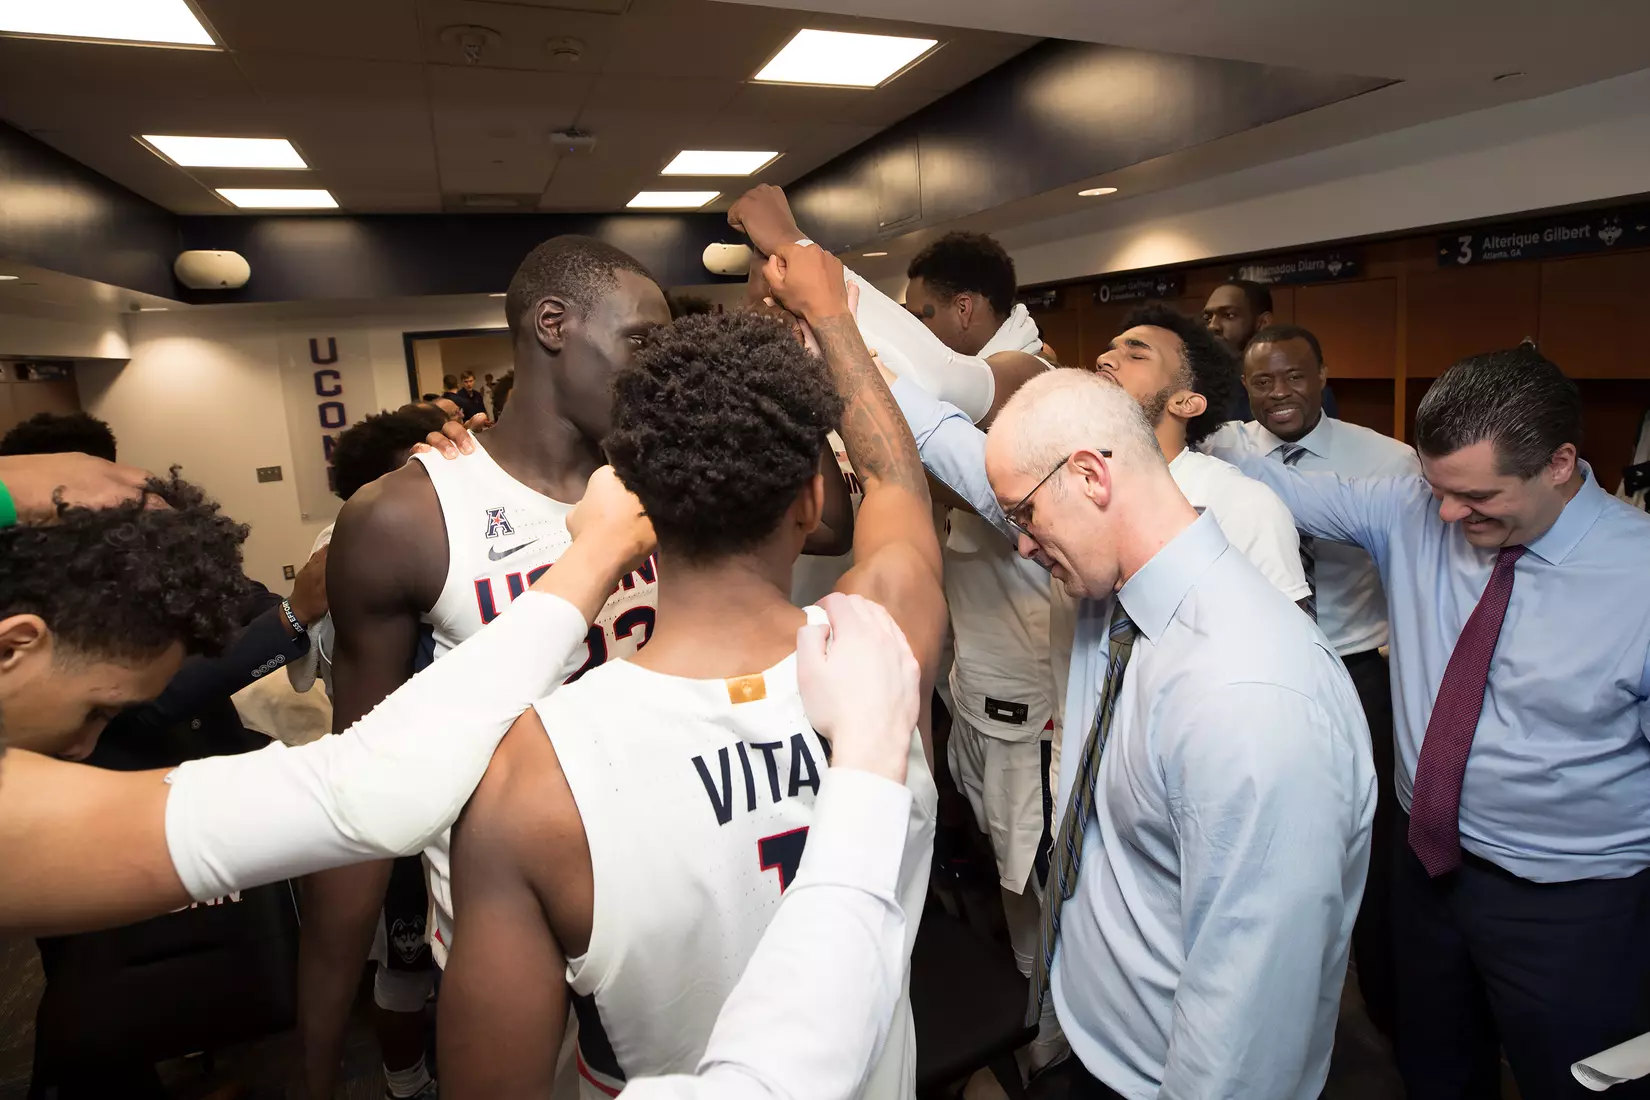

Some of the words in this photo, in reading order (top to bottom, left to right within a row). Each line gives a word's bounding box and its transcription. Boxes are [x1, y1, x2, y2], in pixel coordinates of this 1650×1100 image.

[1457, 235, 1472, 264] 3
[1482, 233, 1540, 250] Alterique
[1543, 224, 1591, 243] Gilbert
[1297, 259, 1325, 272] Diarra
[1100, 285, 1110, 303] 0
[308, 337, 347, 492] UCO
